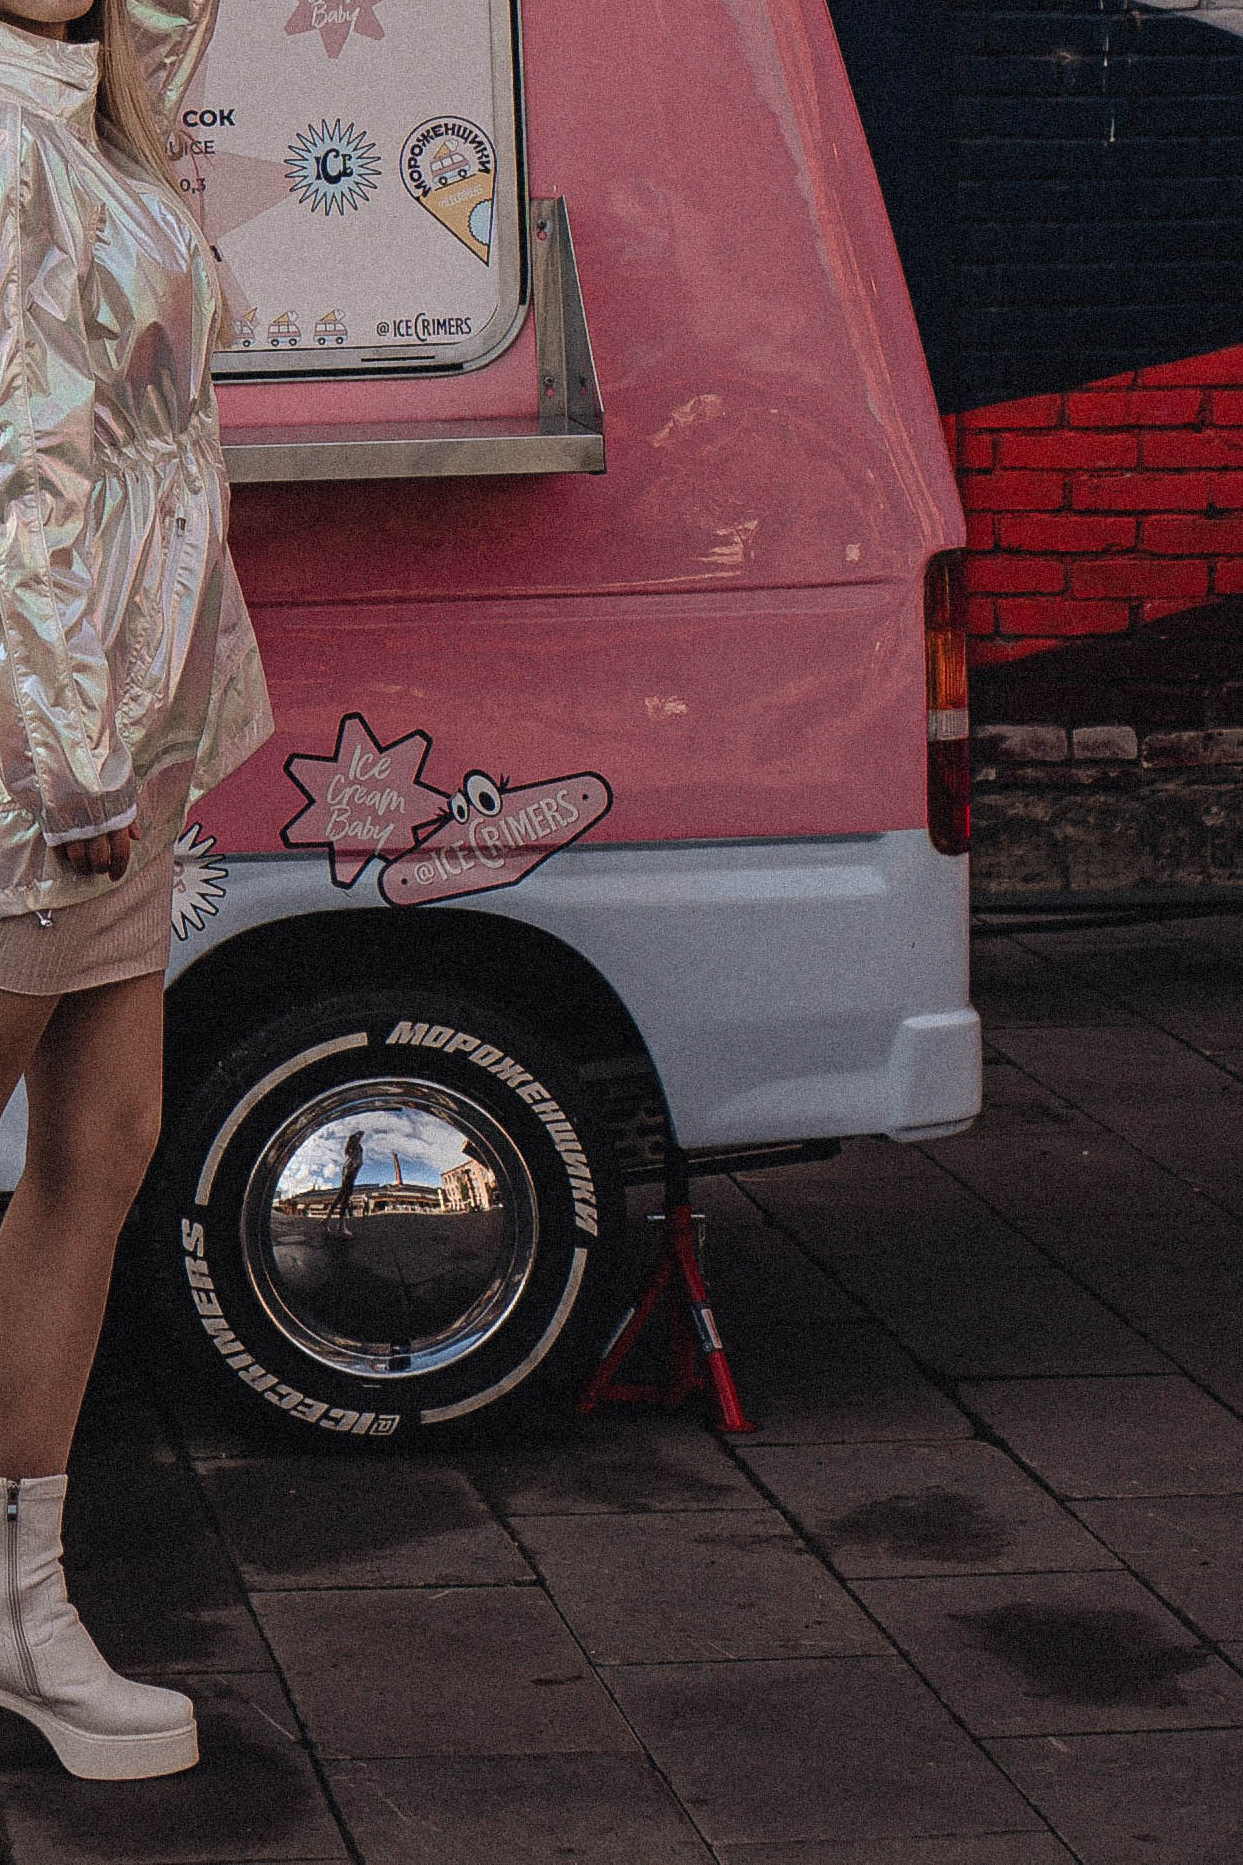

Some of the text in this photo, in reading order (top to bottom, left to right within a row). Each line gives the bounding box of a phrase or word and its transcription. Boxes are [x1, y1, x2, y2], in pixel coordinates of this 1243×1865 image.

[311, 4, 361, 32] Baby
[182, 109, 236, 127] СОК
[313, 148, 354, 185] ICE
[407, 123, 492, 199] МОРОЖЕНЩИКИ
[180, 178, 207, 194] 0,3
[375, 313, 472, 343] @ICECRIMERS
[348, 745, 392, 783] Ice
[326, 773, 406, 815] Cream
[325, 805, 396, 851] Baby
[413, 788, 581, 886] @ICECRIMERS
[385, 1021, 599, 1236] МОРОЖЕНЩИКИ
[181, 1218, 401, 1436] @ICECRIMERS
